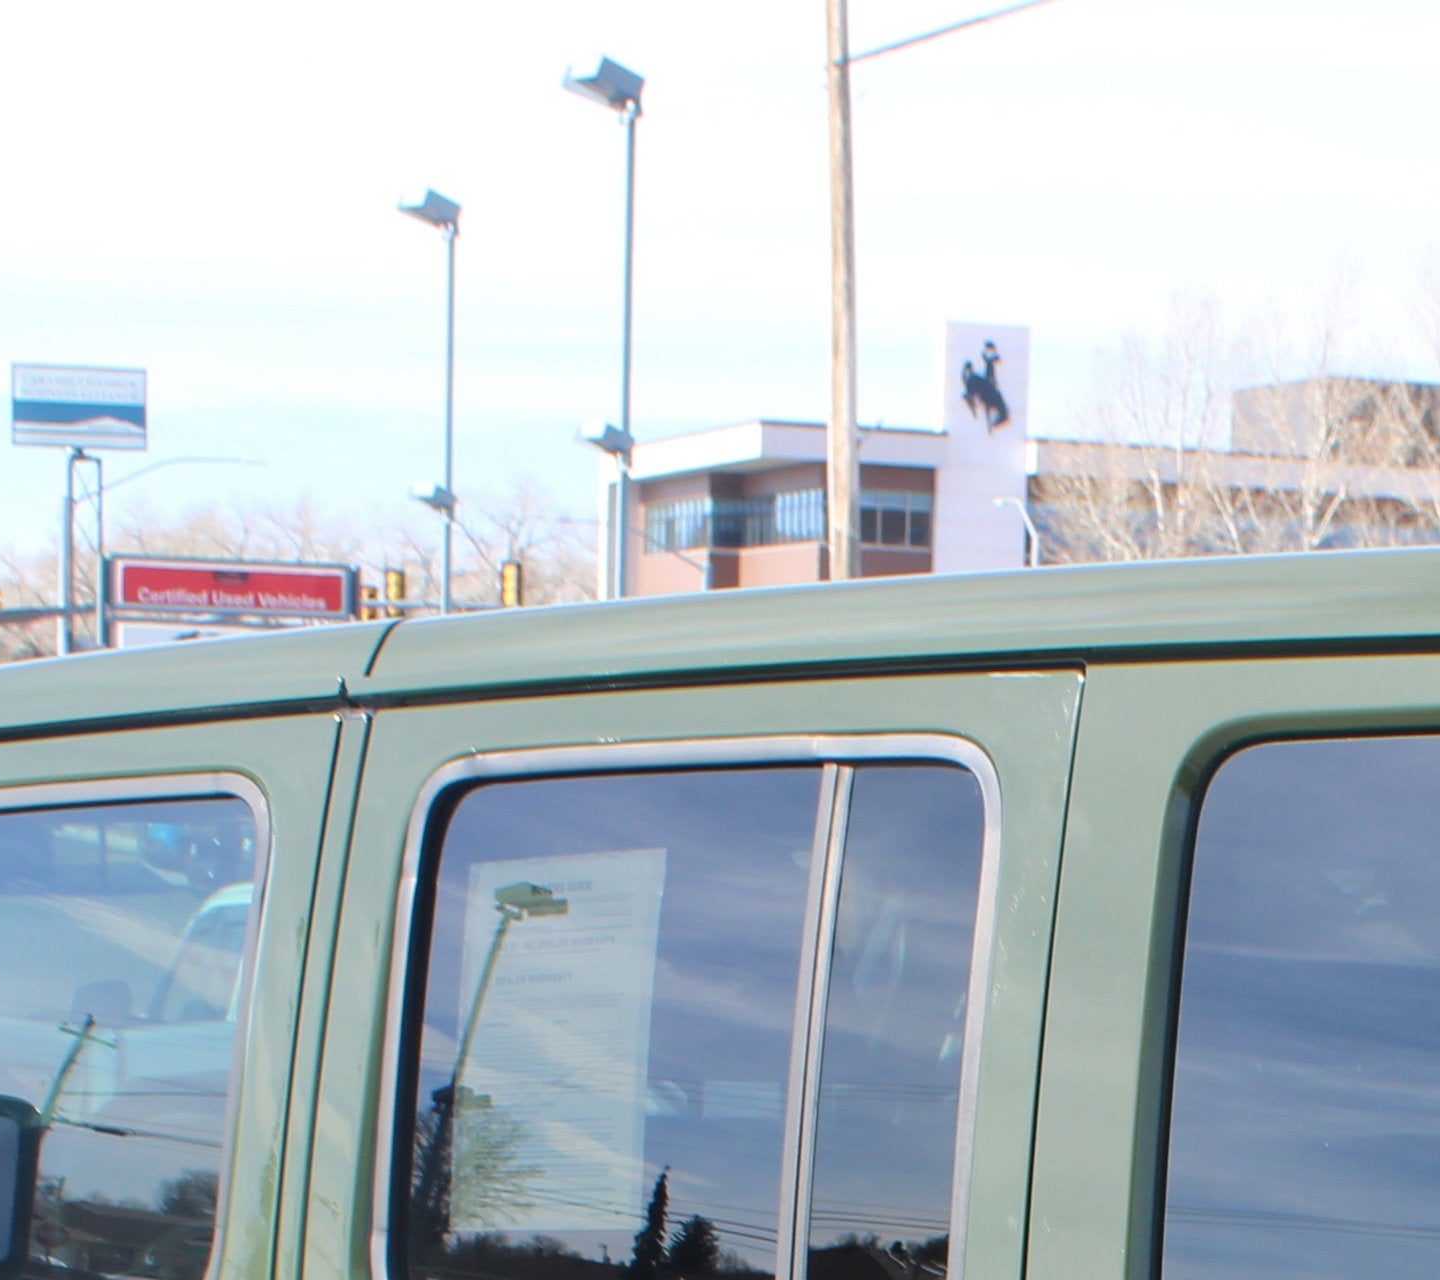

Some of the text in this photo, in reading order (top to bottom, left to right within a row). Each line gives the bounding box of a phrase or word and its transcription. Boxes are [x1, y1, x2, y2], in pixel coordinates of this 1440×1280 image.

[137, 586, 328, 610] Certified Used Vehicles
